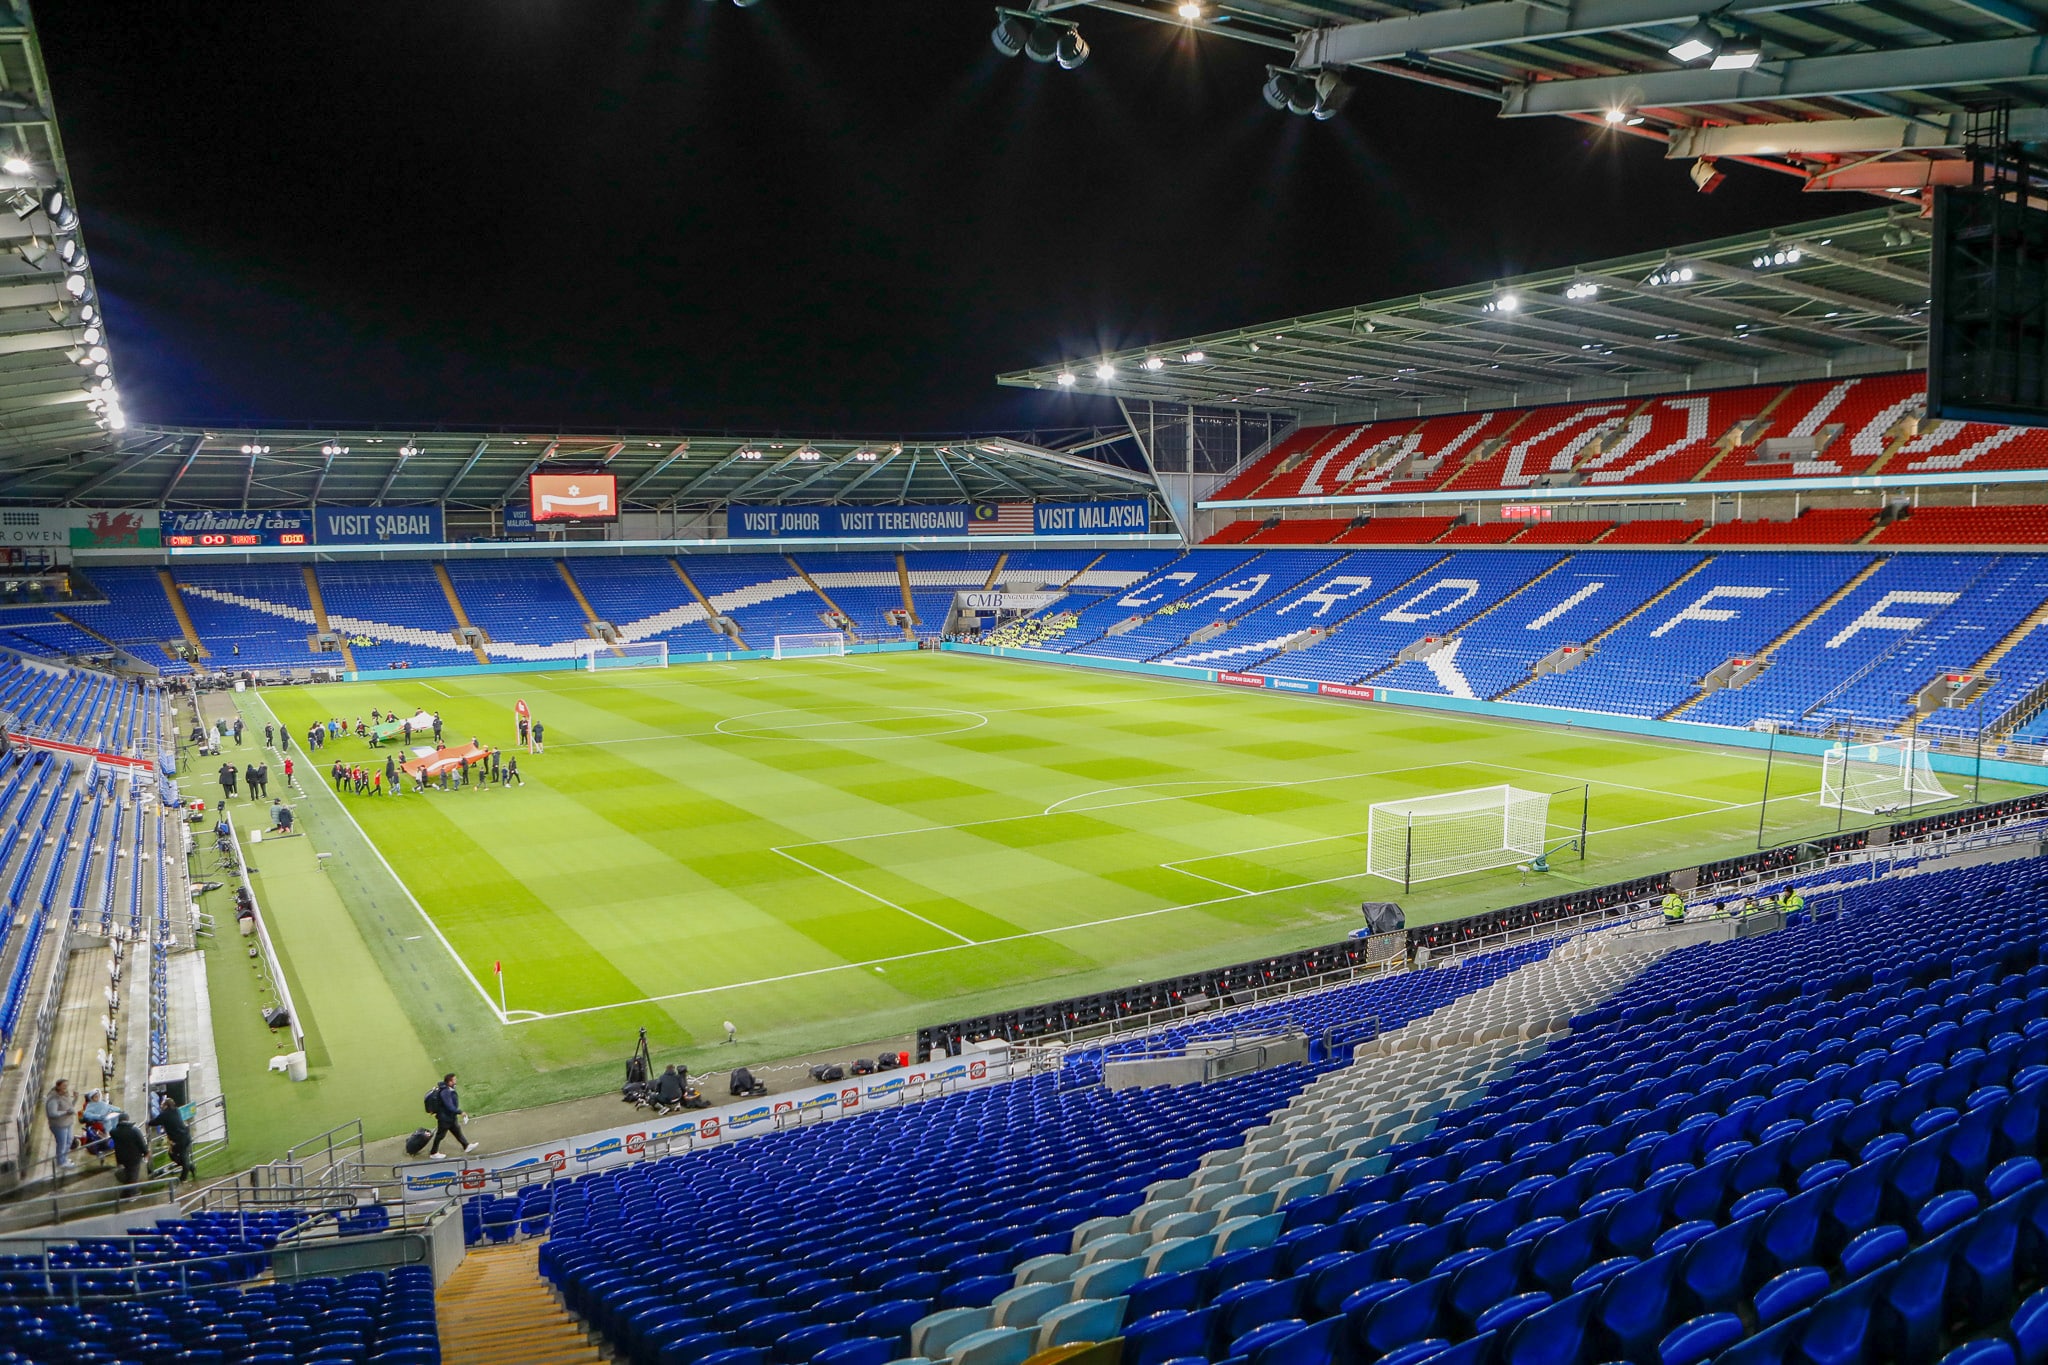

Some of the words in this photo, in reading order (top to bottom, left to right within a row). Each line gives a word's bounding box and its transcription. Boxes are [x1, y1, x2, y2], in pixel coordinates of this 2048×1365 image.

[173, 513, 265, 531] Nathaniel
[265, 519, 301, 529] cars
[512, 510, 527, 519] VISIT
[744, 513, 777, 530] VISIT
[780, 513, 820, 530] JOHOR
[840, 512, 874, 530] VISIT
[877, 511, 964, 529] TERENGGANU
[1038, 509, 1075, 528] VISIT
[1079, 506, 1143, 528] MALAYSIA
[328, 515, 371, 536] VISIT
[375, 514, 430, 536] SABAH
[13, 531, 62, 541] OWEN
[282, 534, 304, 544] 00:00
[966, 593, 1003, 607] CMB
[1117, 571, 1961, 649] CARDIFF
